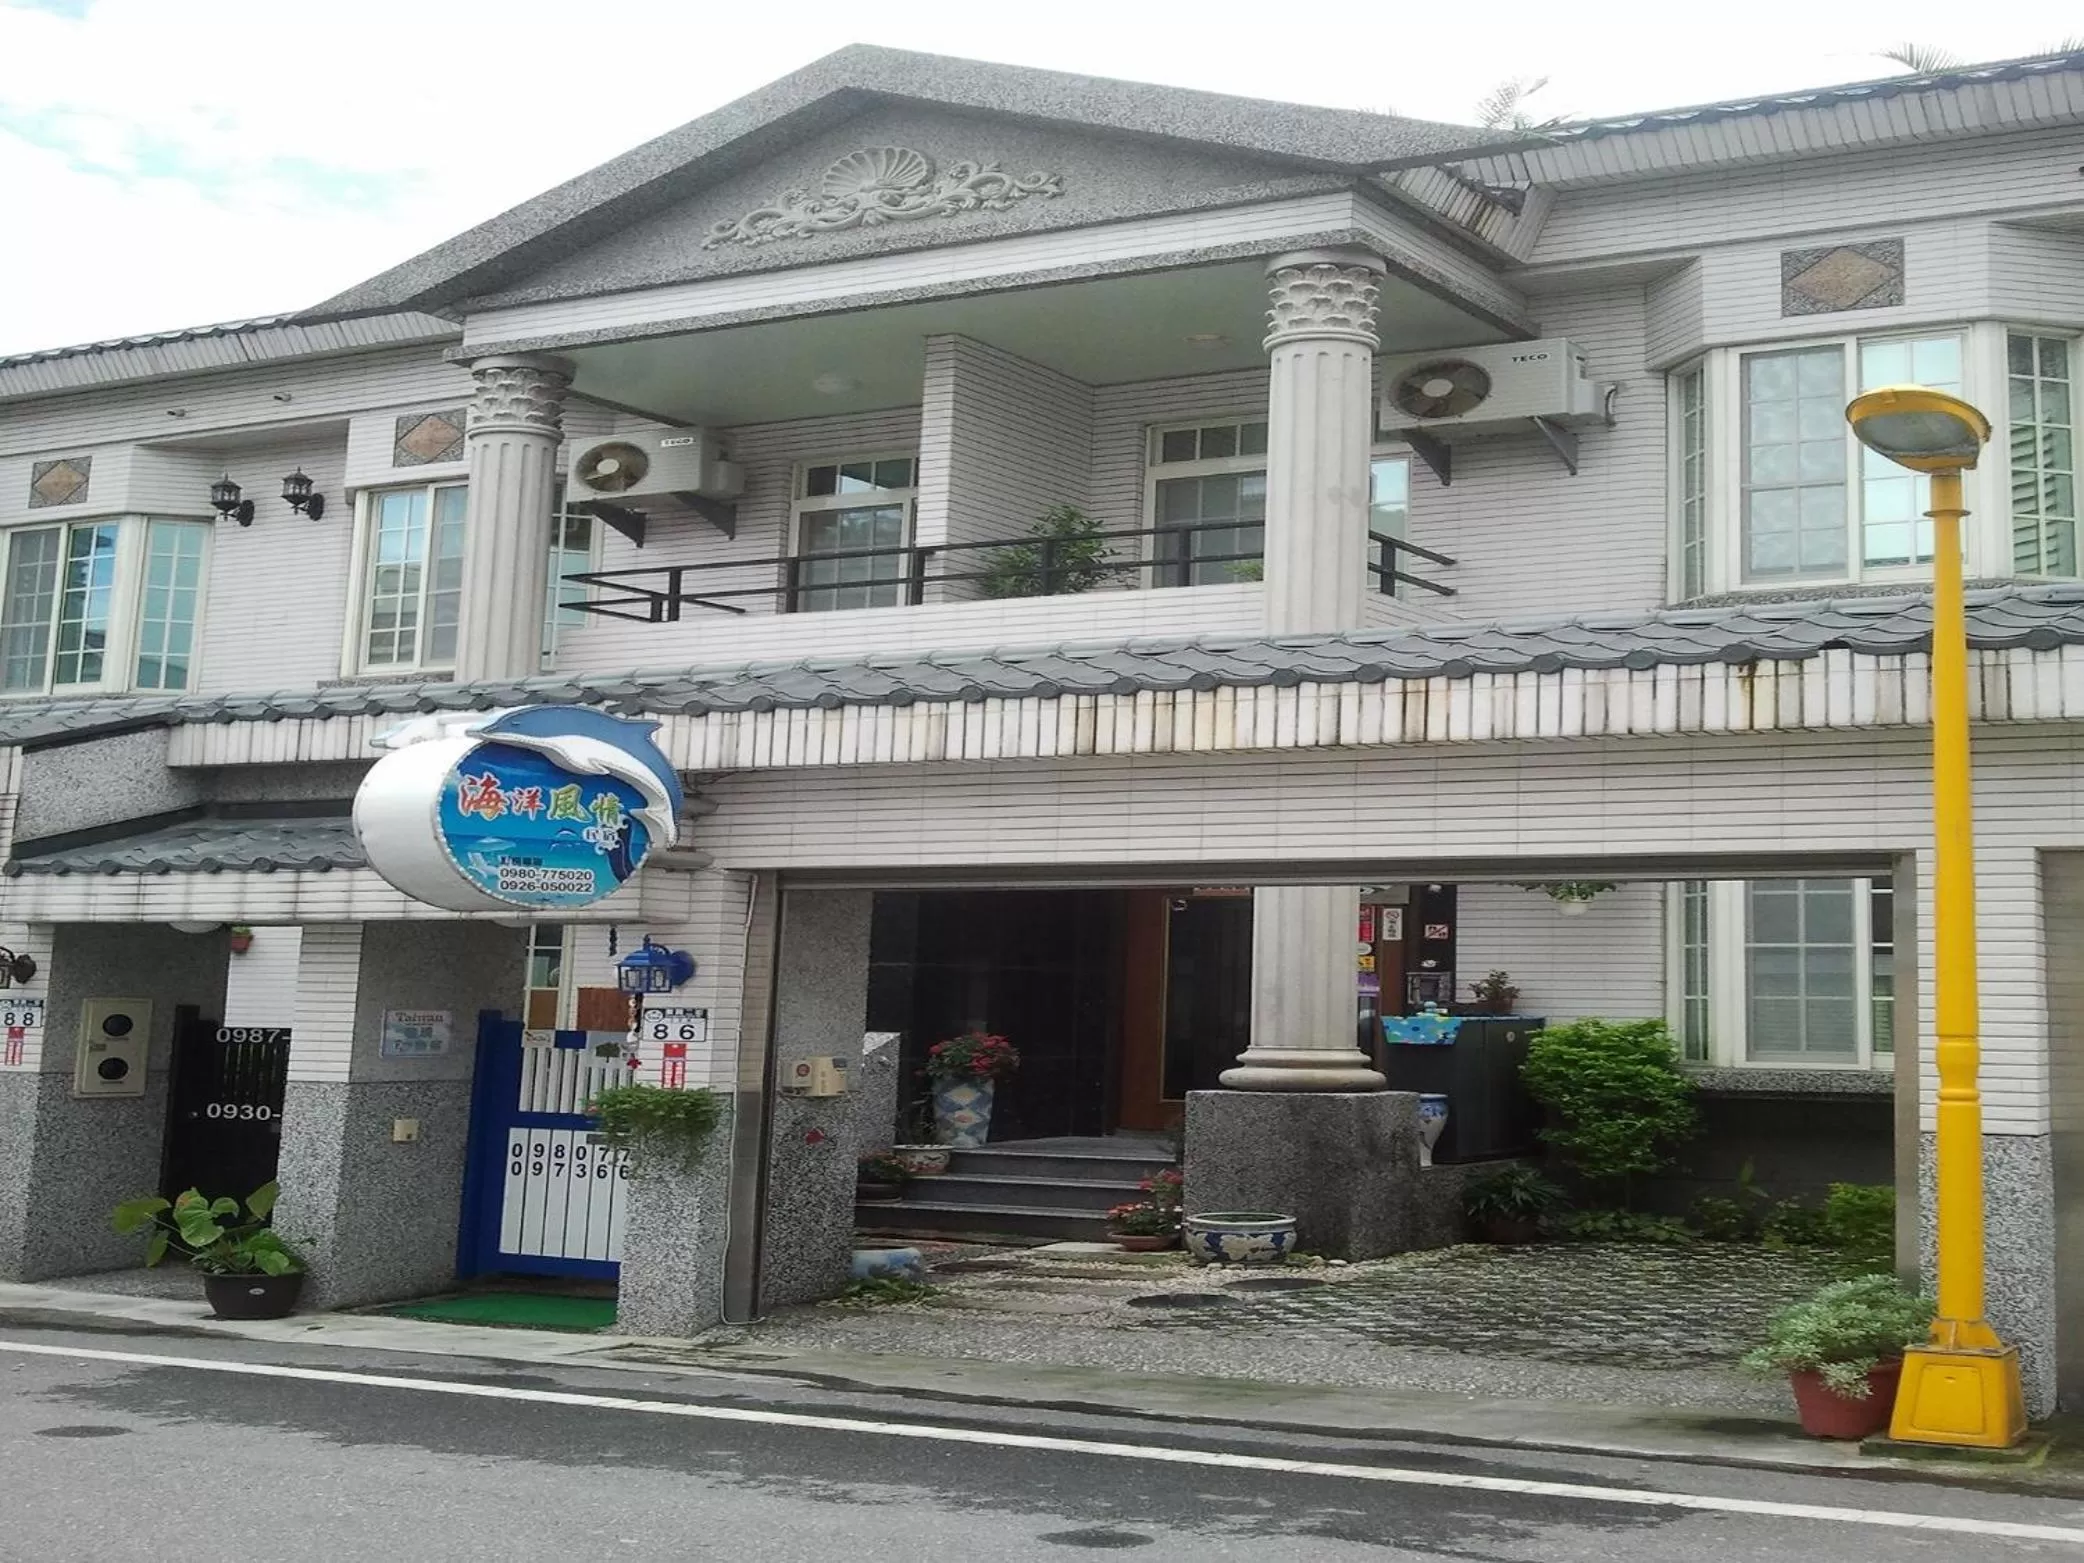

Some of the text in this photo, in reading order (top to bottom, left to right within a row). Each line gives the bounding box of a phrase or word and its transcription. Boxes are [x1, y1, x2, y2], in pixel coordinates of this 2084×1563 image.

[1511, 353, 1548, 362] TECO
[460, 773, 622, 826] 海洋風情
[500, 867, 593, 881] 0980-775020
[500, 880, 593, 893] 0926-050022
[4, 1012, 34, 1026] 88
[653, 1023, 695, 1040] 86
